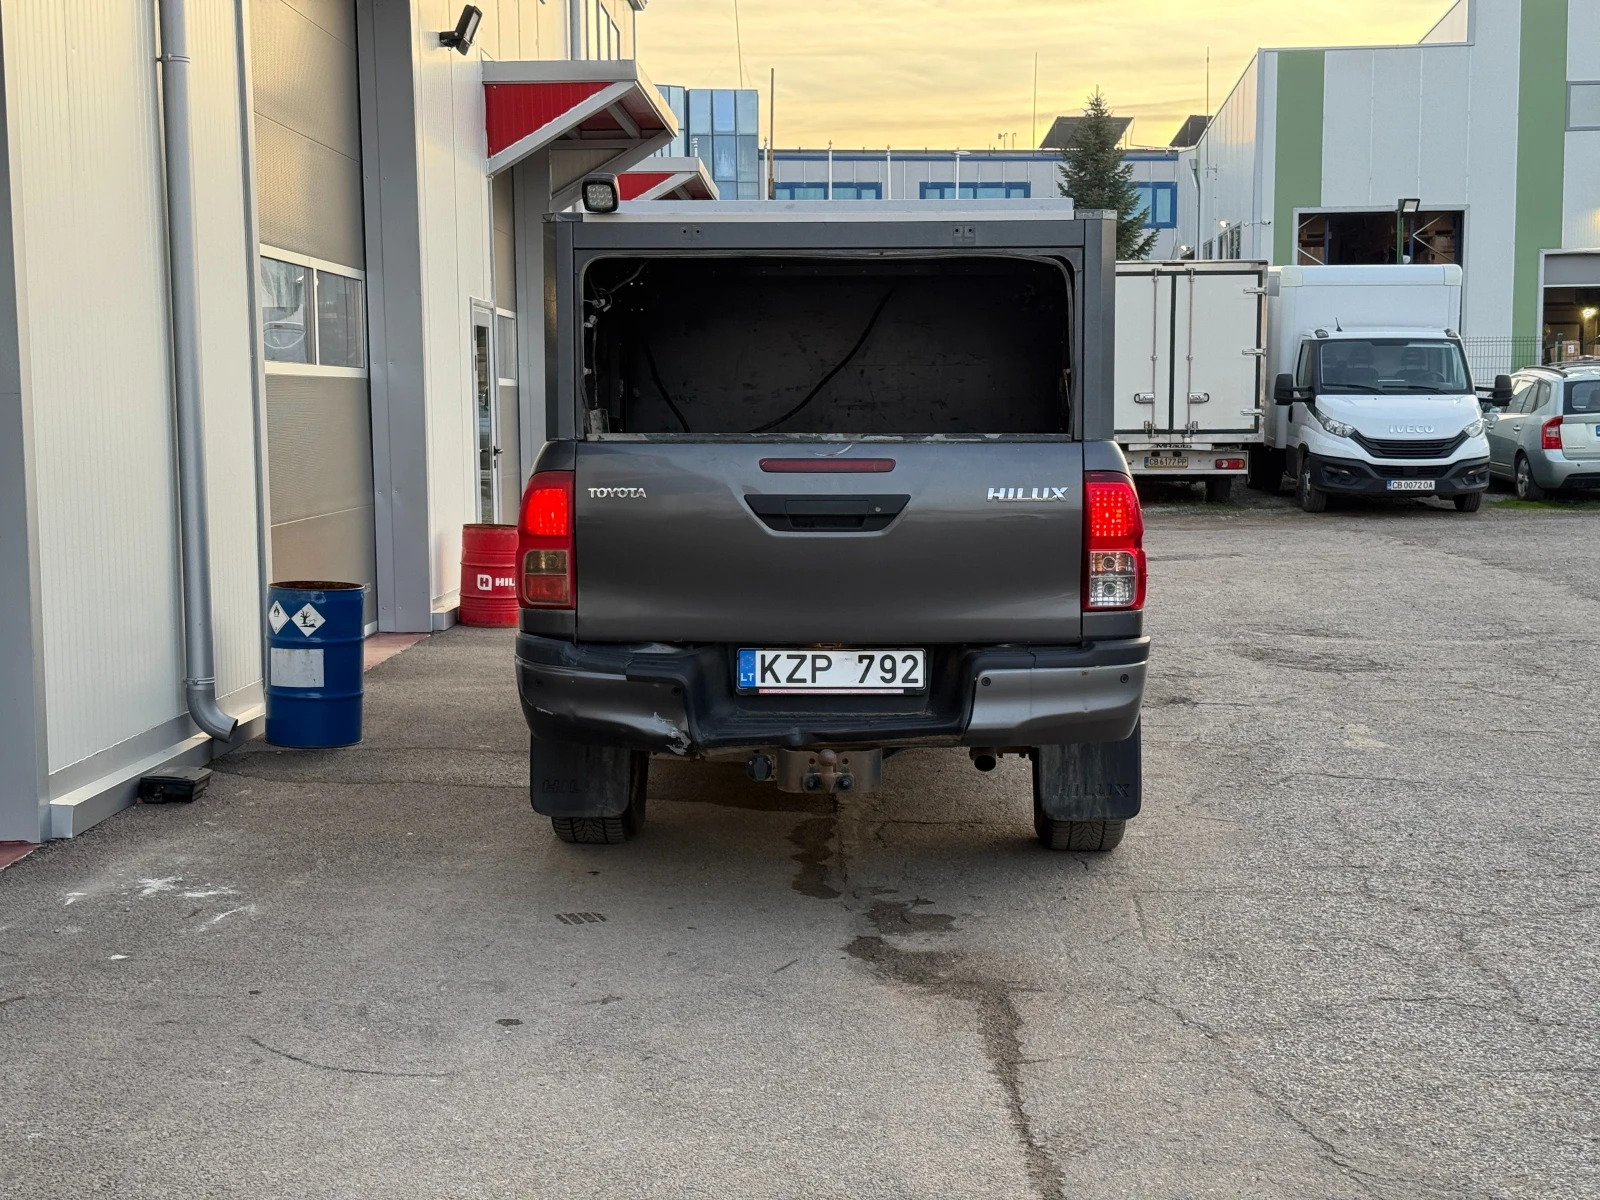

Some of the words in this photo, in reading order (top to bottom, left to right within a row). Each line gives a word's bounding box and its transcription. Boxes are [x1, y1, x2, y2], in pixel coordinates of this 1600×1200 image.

[1389, 424, 1435, 433] IVECO
[1160, 458, 1177, 466] 6177
[1392, 481, 1403, 489] CB
[1403, 481, 1423, 489] 0072
[588, 487, 647, 498] TOYOTA
[987, 487, 1069, 501] HILUX
[496, 577, 515, 587] HIL
[760, 654, 833, 684] KZP
[858, 654, 919, 684] 792
[740, 673, 754, 682] LT
